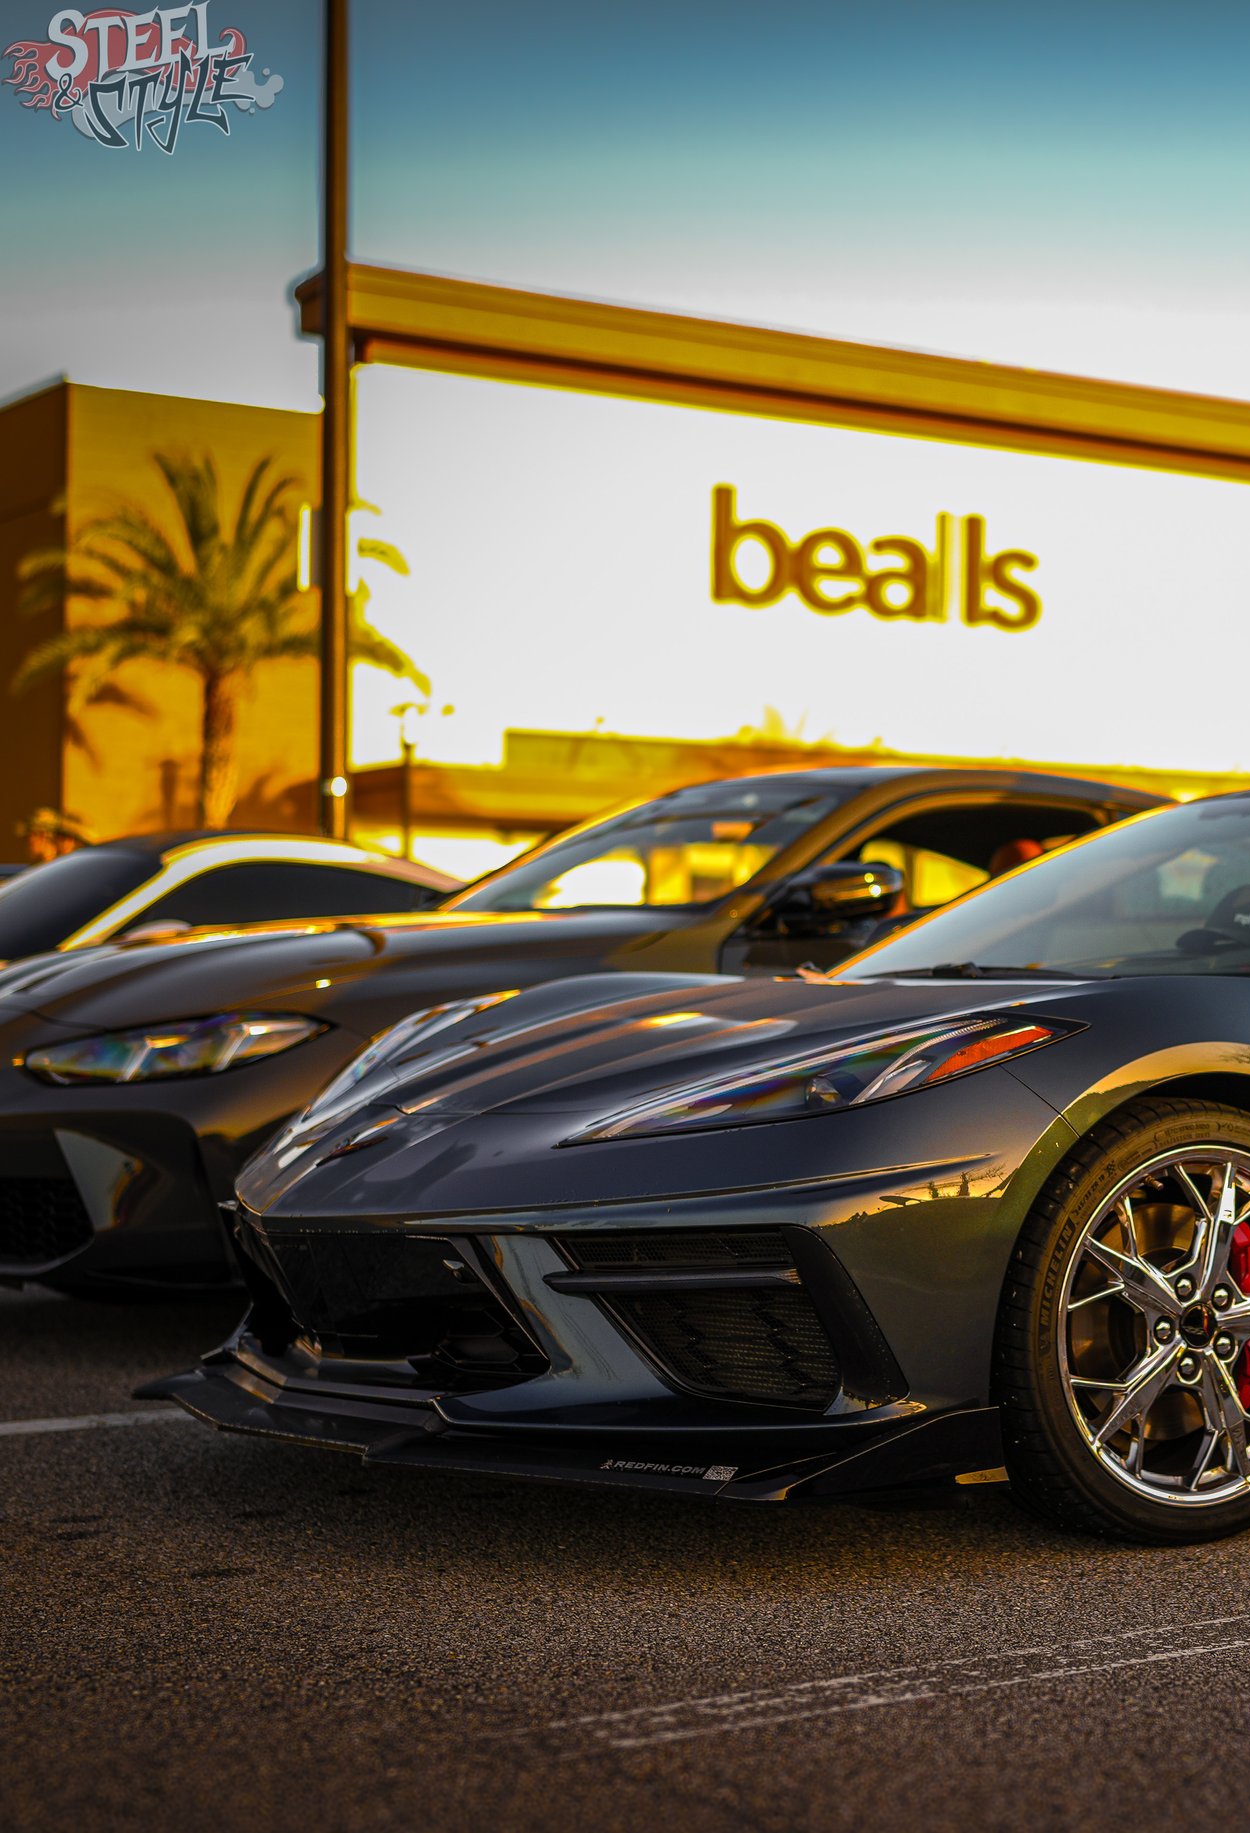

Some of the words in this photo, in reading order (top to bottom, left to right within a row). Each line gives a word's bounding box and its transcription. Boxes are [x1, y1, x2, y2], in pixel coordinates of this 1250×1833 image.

[711, 482, 1043, 633] bealls
[1040, 1225, 1074, 1327] MICHELIN
[613, 1460, 706, 1475] REDFIN.COM
